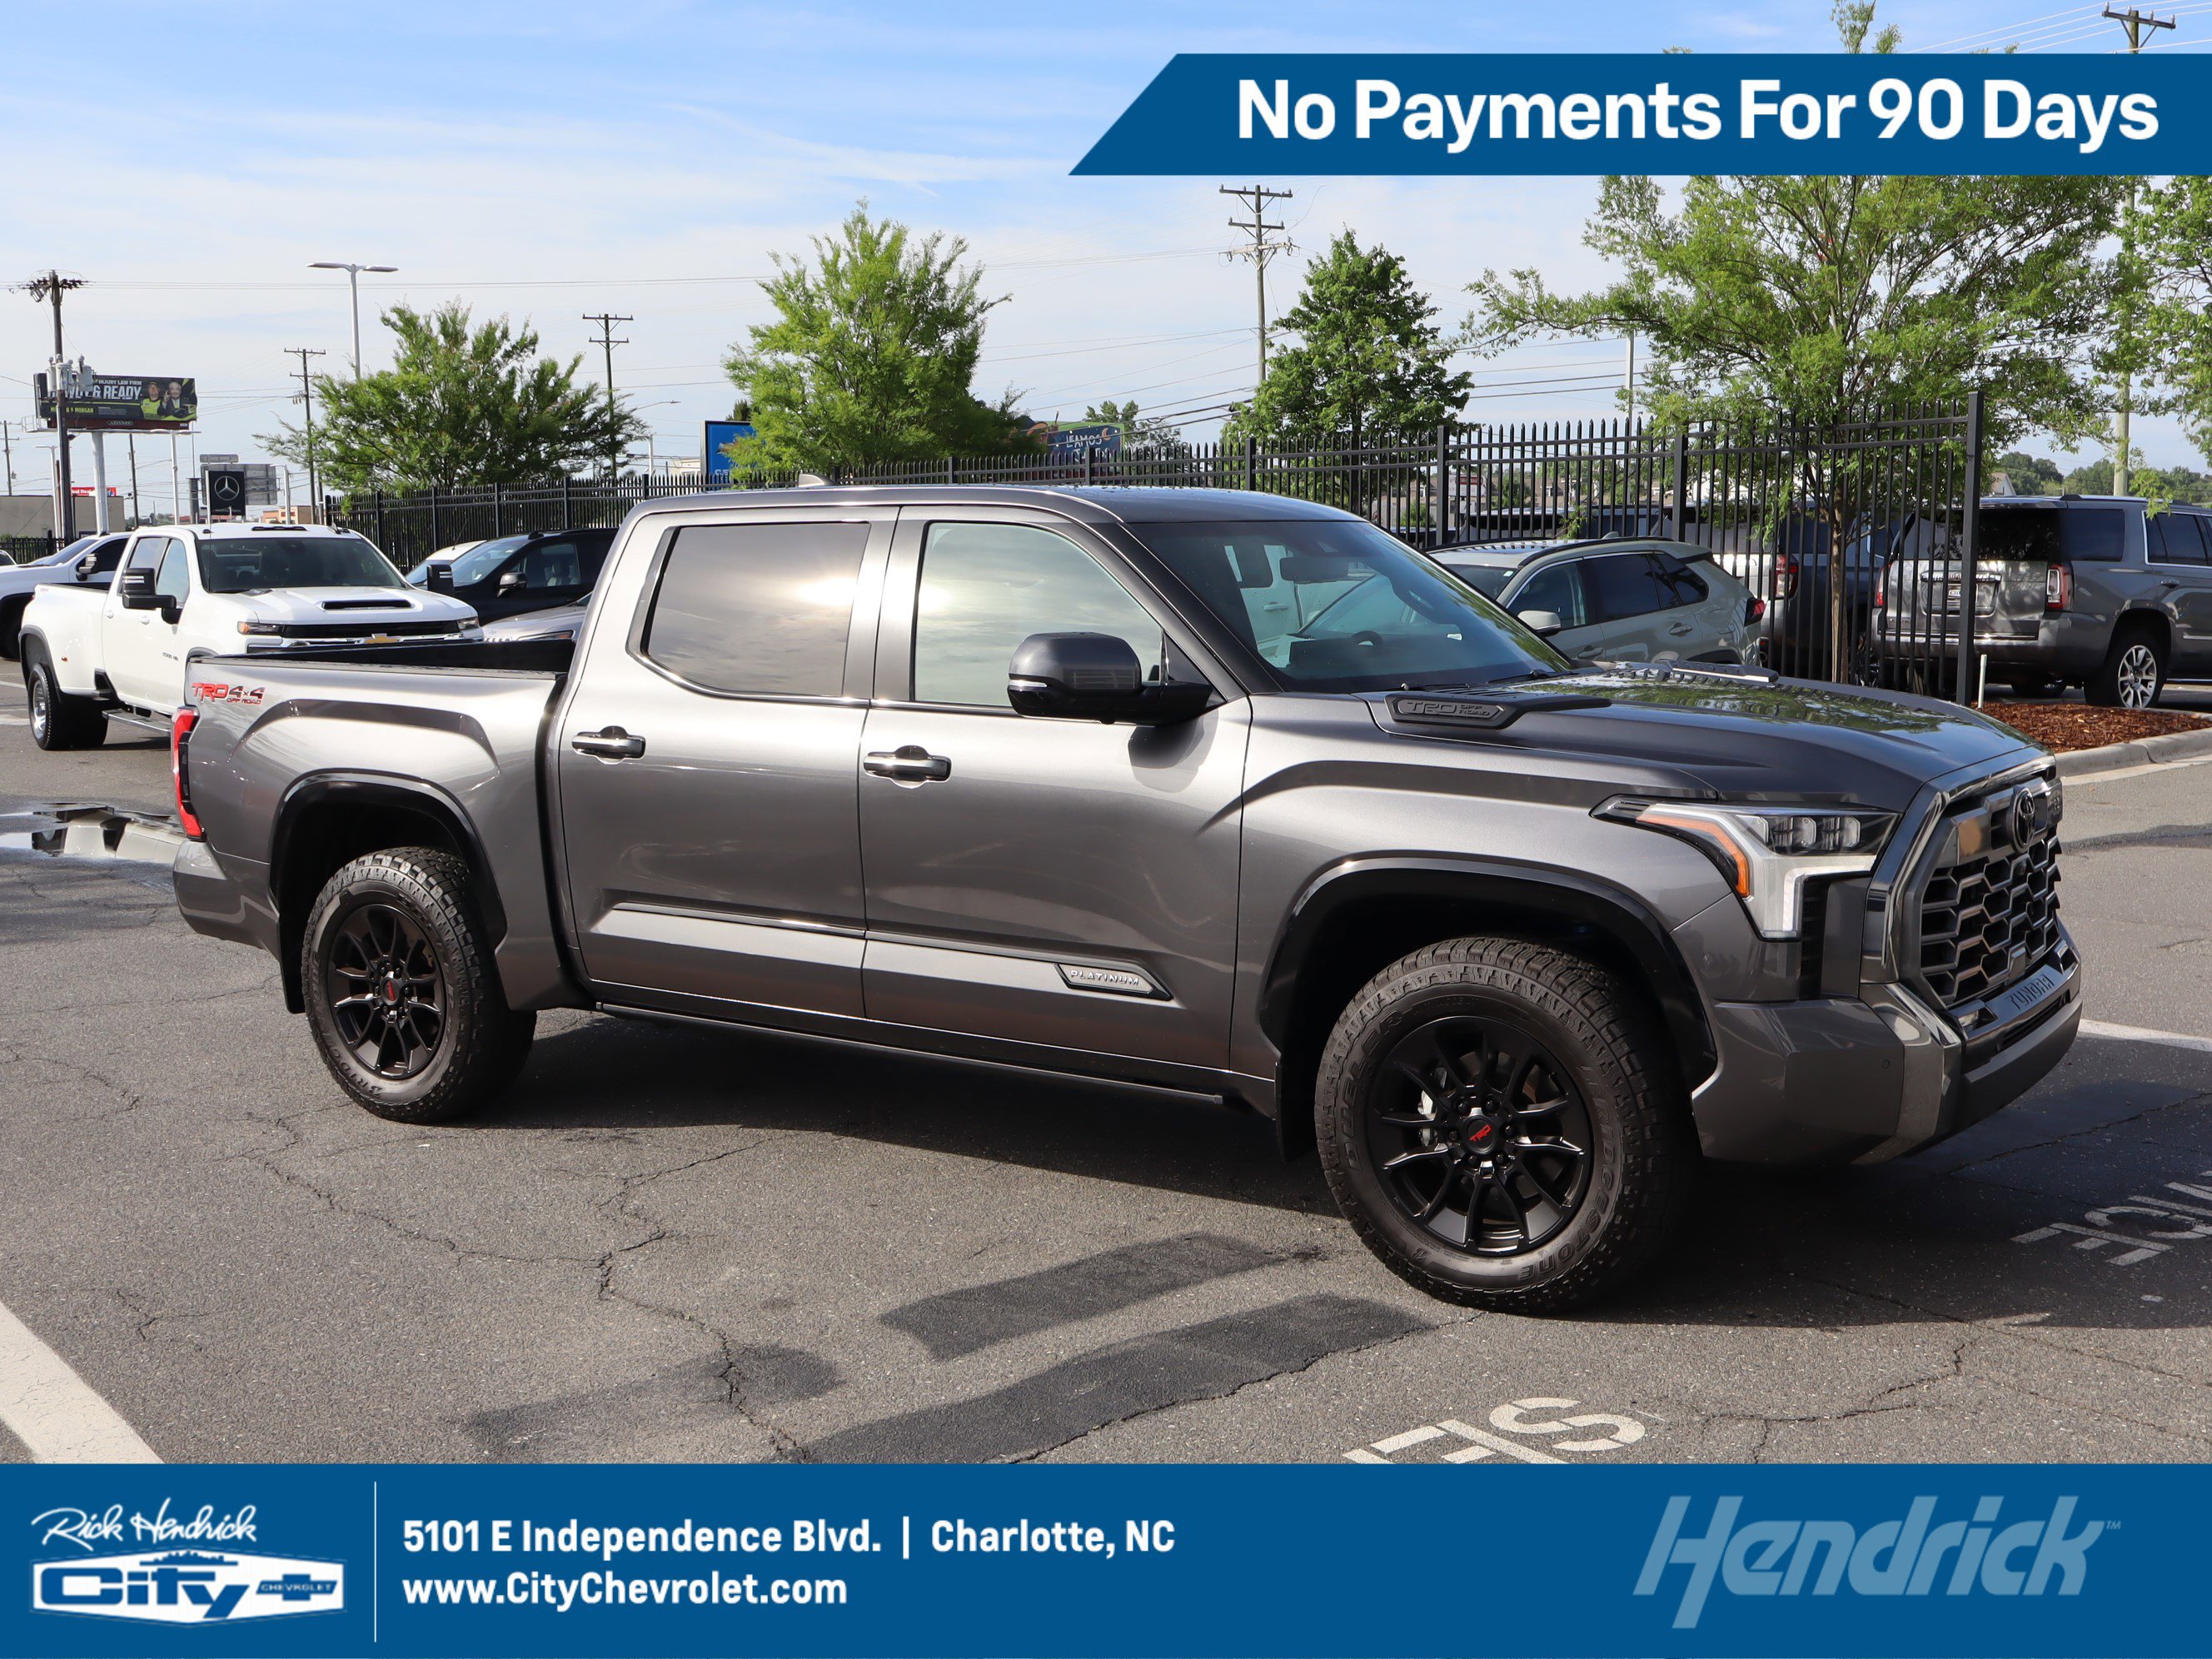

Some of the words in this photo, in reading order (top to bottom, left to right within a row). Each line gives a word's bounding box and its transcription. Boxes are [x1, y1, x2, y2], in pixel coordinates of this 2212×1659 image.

[103, 386, 142, 401] READY
[192, 683, 229, 702] TRD
[1407, 701, 1457, 715] TRD
[1070, 969, 1139, 986] PLATINUM
[2005, 974, 2055, 1010] TUNDRA
[1469, 1124, 1492, 1142] TRD
